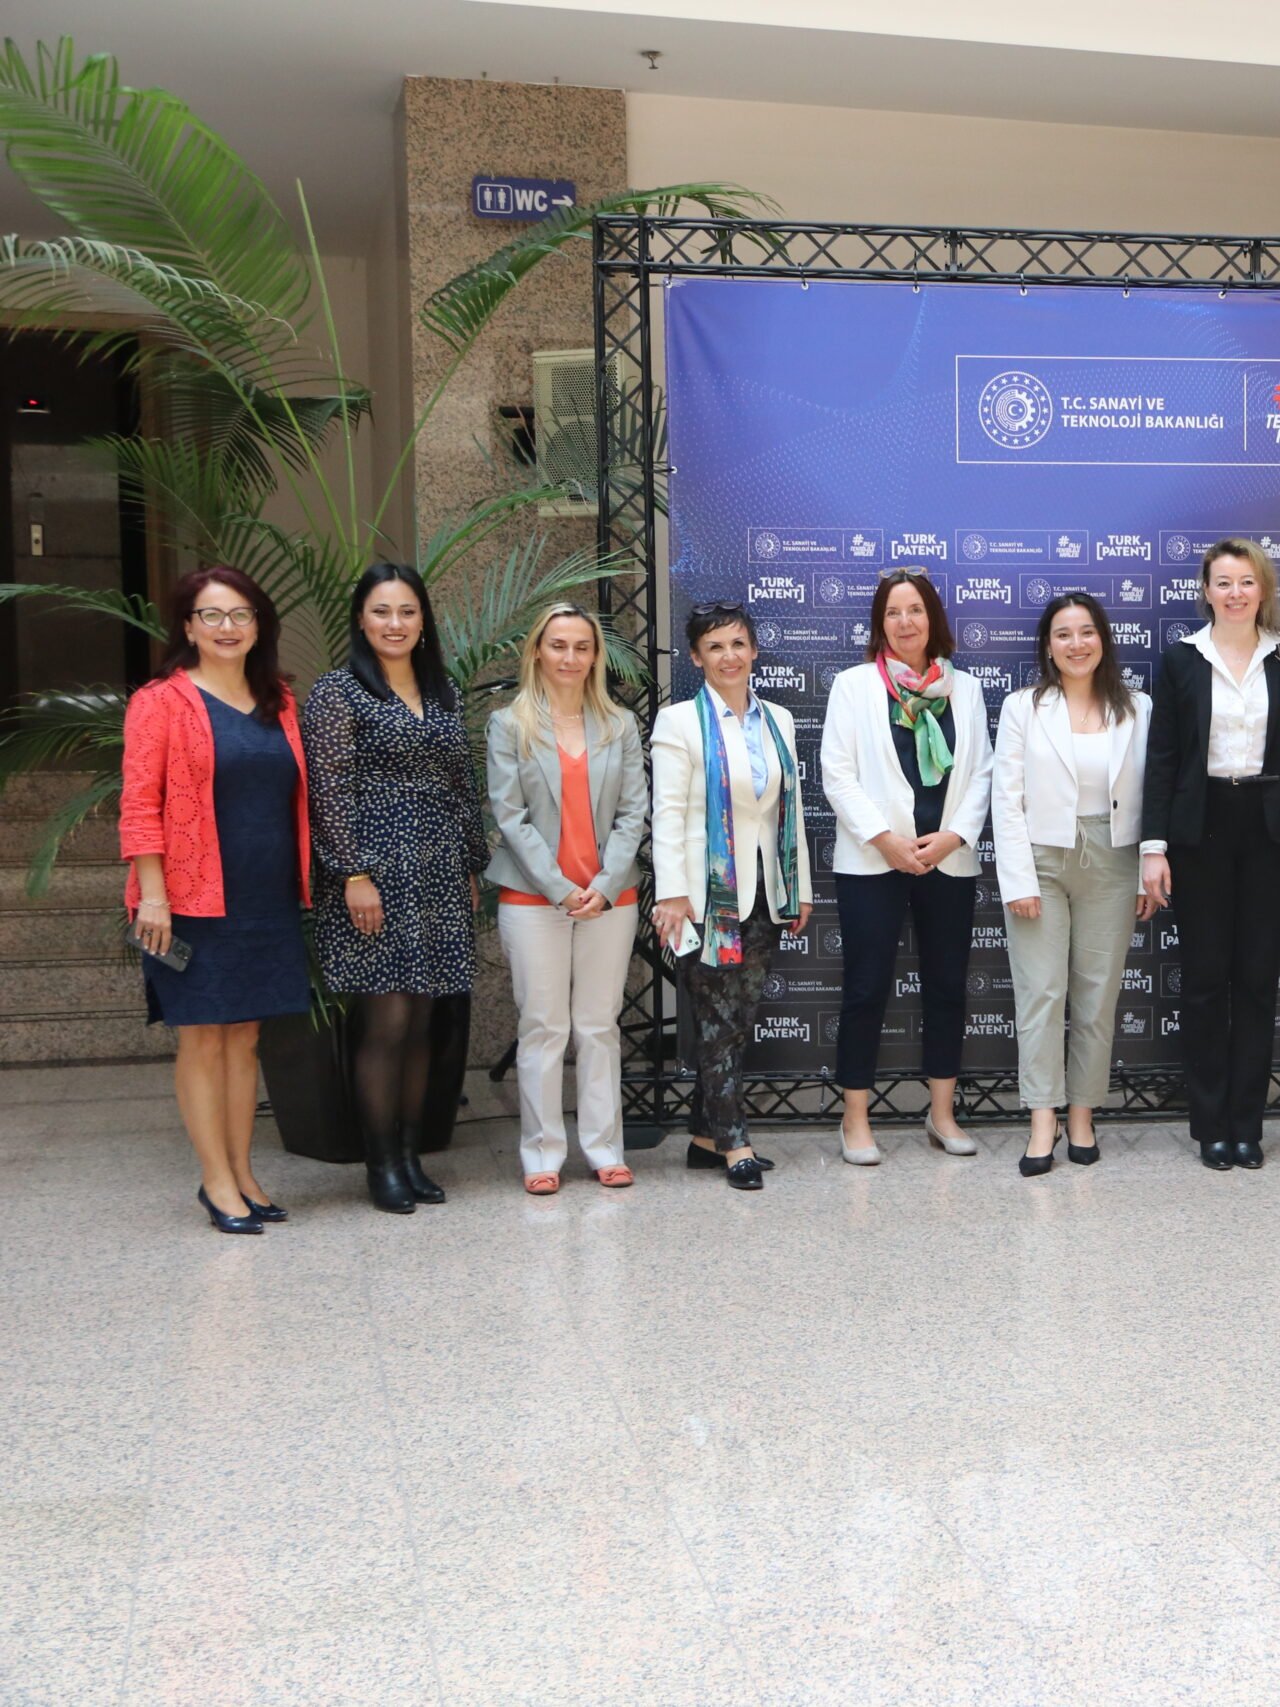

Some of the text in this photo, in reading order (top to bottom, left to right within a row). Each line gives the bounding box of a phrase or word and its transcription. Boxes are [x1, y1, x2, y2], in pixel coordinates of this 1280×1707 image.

[514, 188, 548, 212] WC
[1061, 397, 1086, 410] T.C.
[1146, 398, 1164, 411] VE
